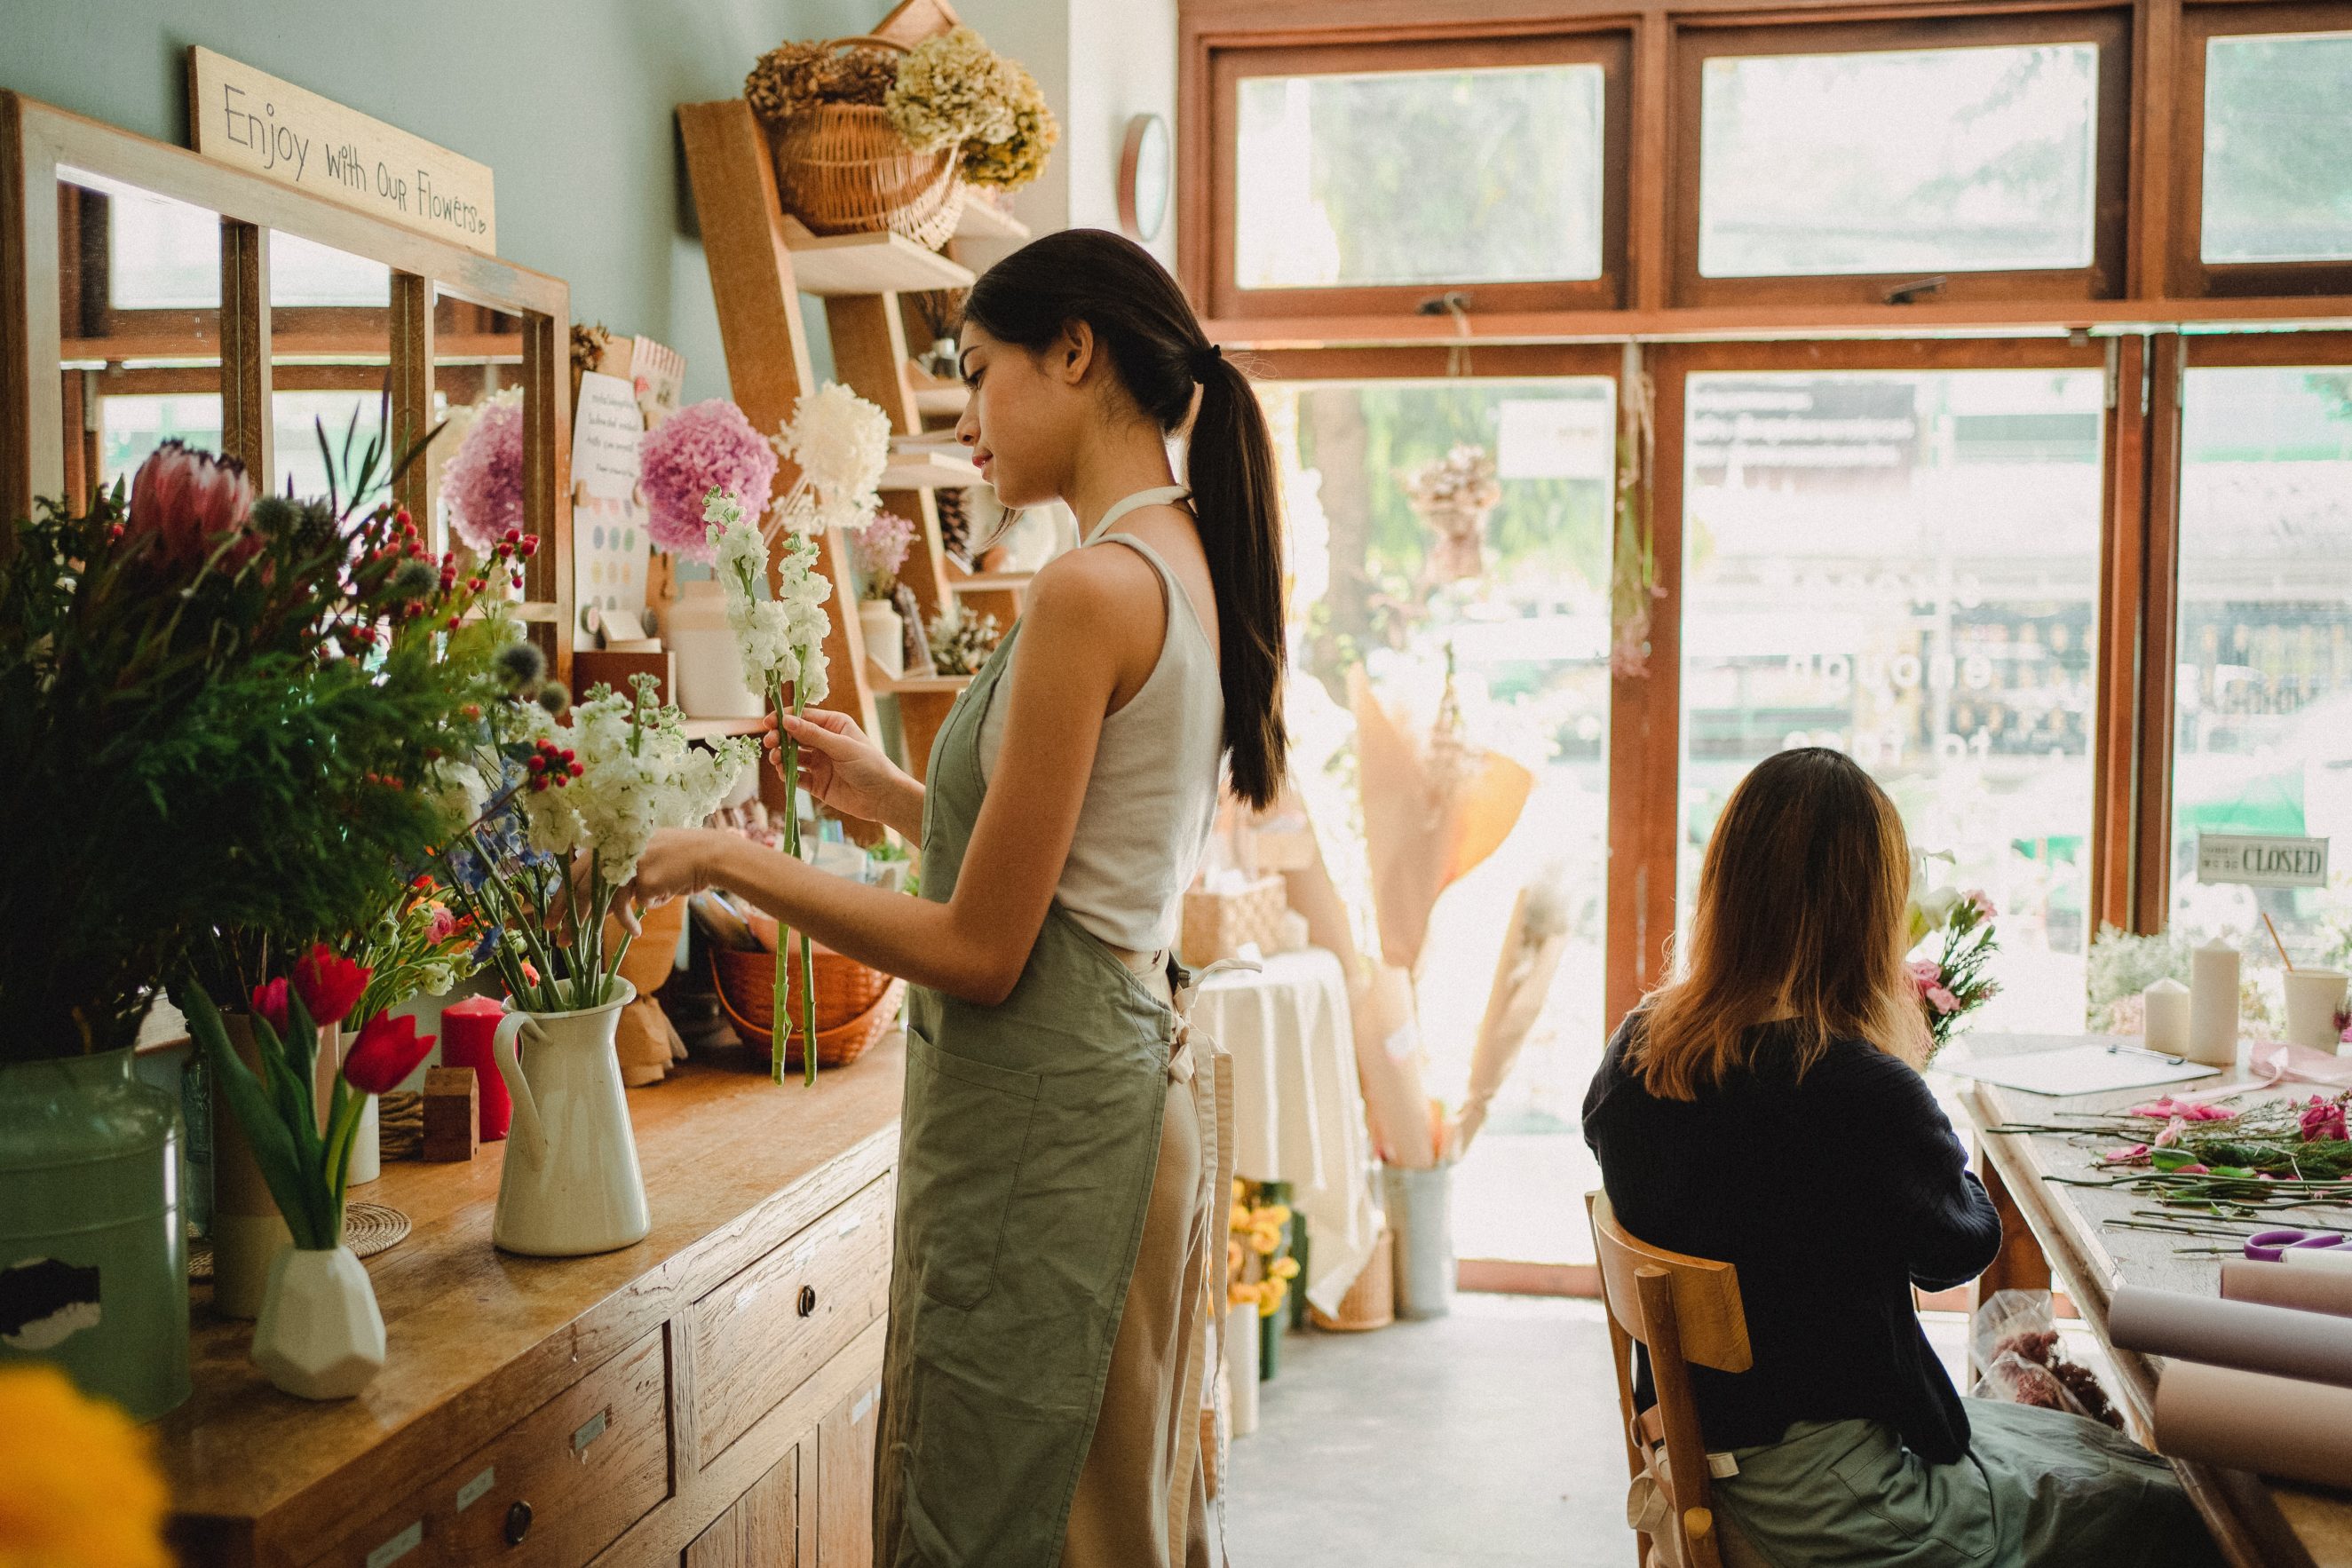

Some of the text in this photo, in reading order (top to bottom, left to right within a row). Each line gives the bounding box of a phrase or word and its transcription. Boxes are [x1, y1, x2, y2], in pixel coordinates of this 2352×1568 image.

[224, 83, 309, 181] Enjoy
[417, 170, 478, 233] Flowers
[2243, 845, 2322, 876] CLOSED
